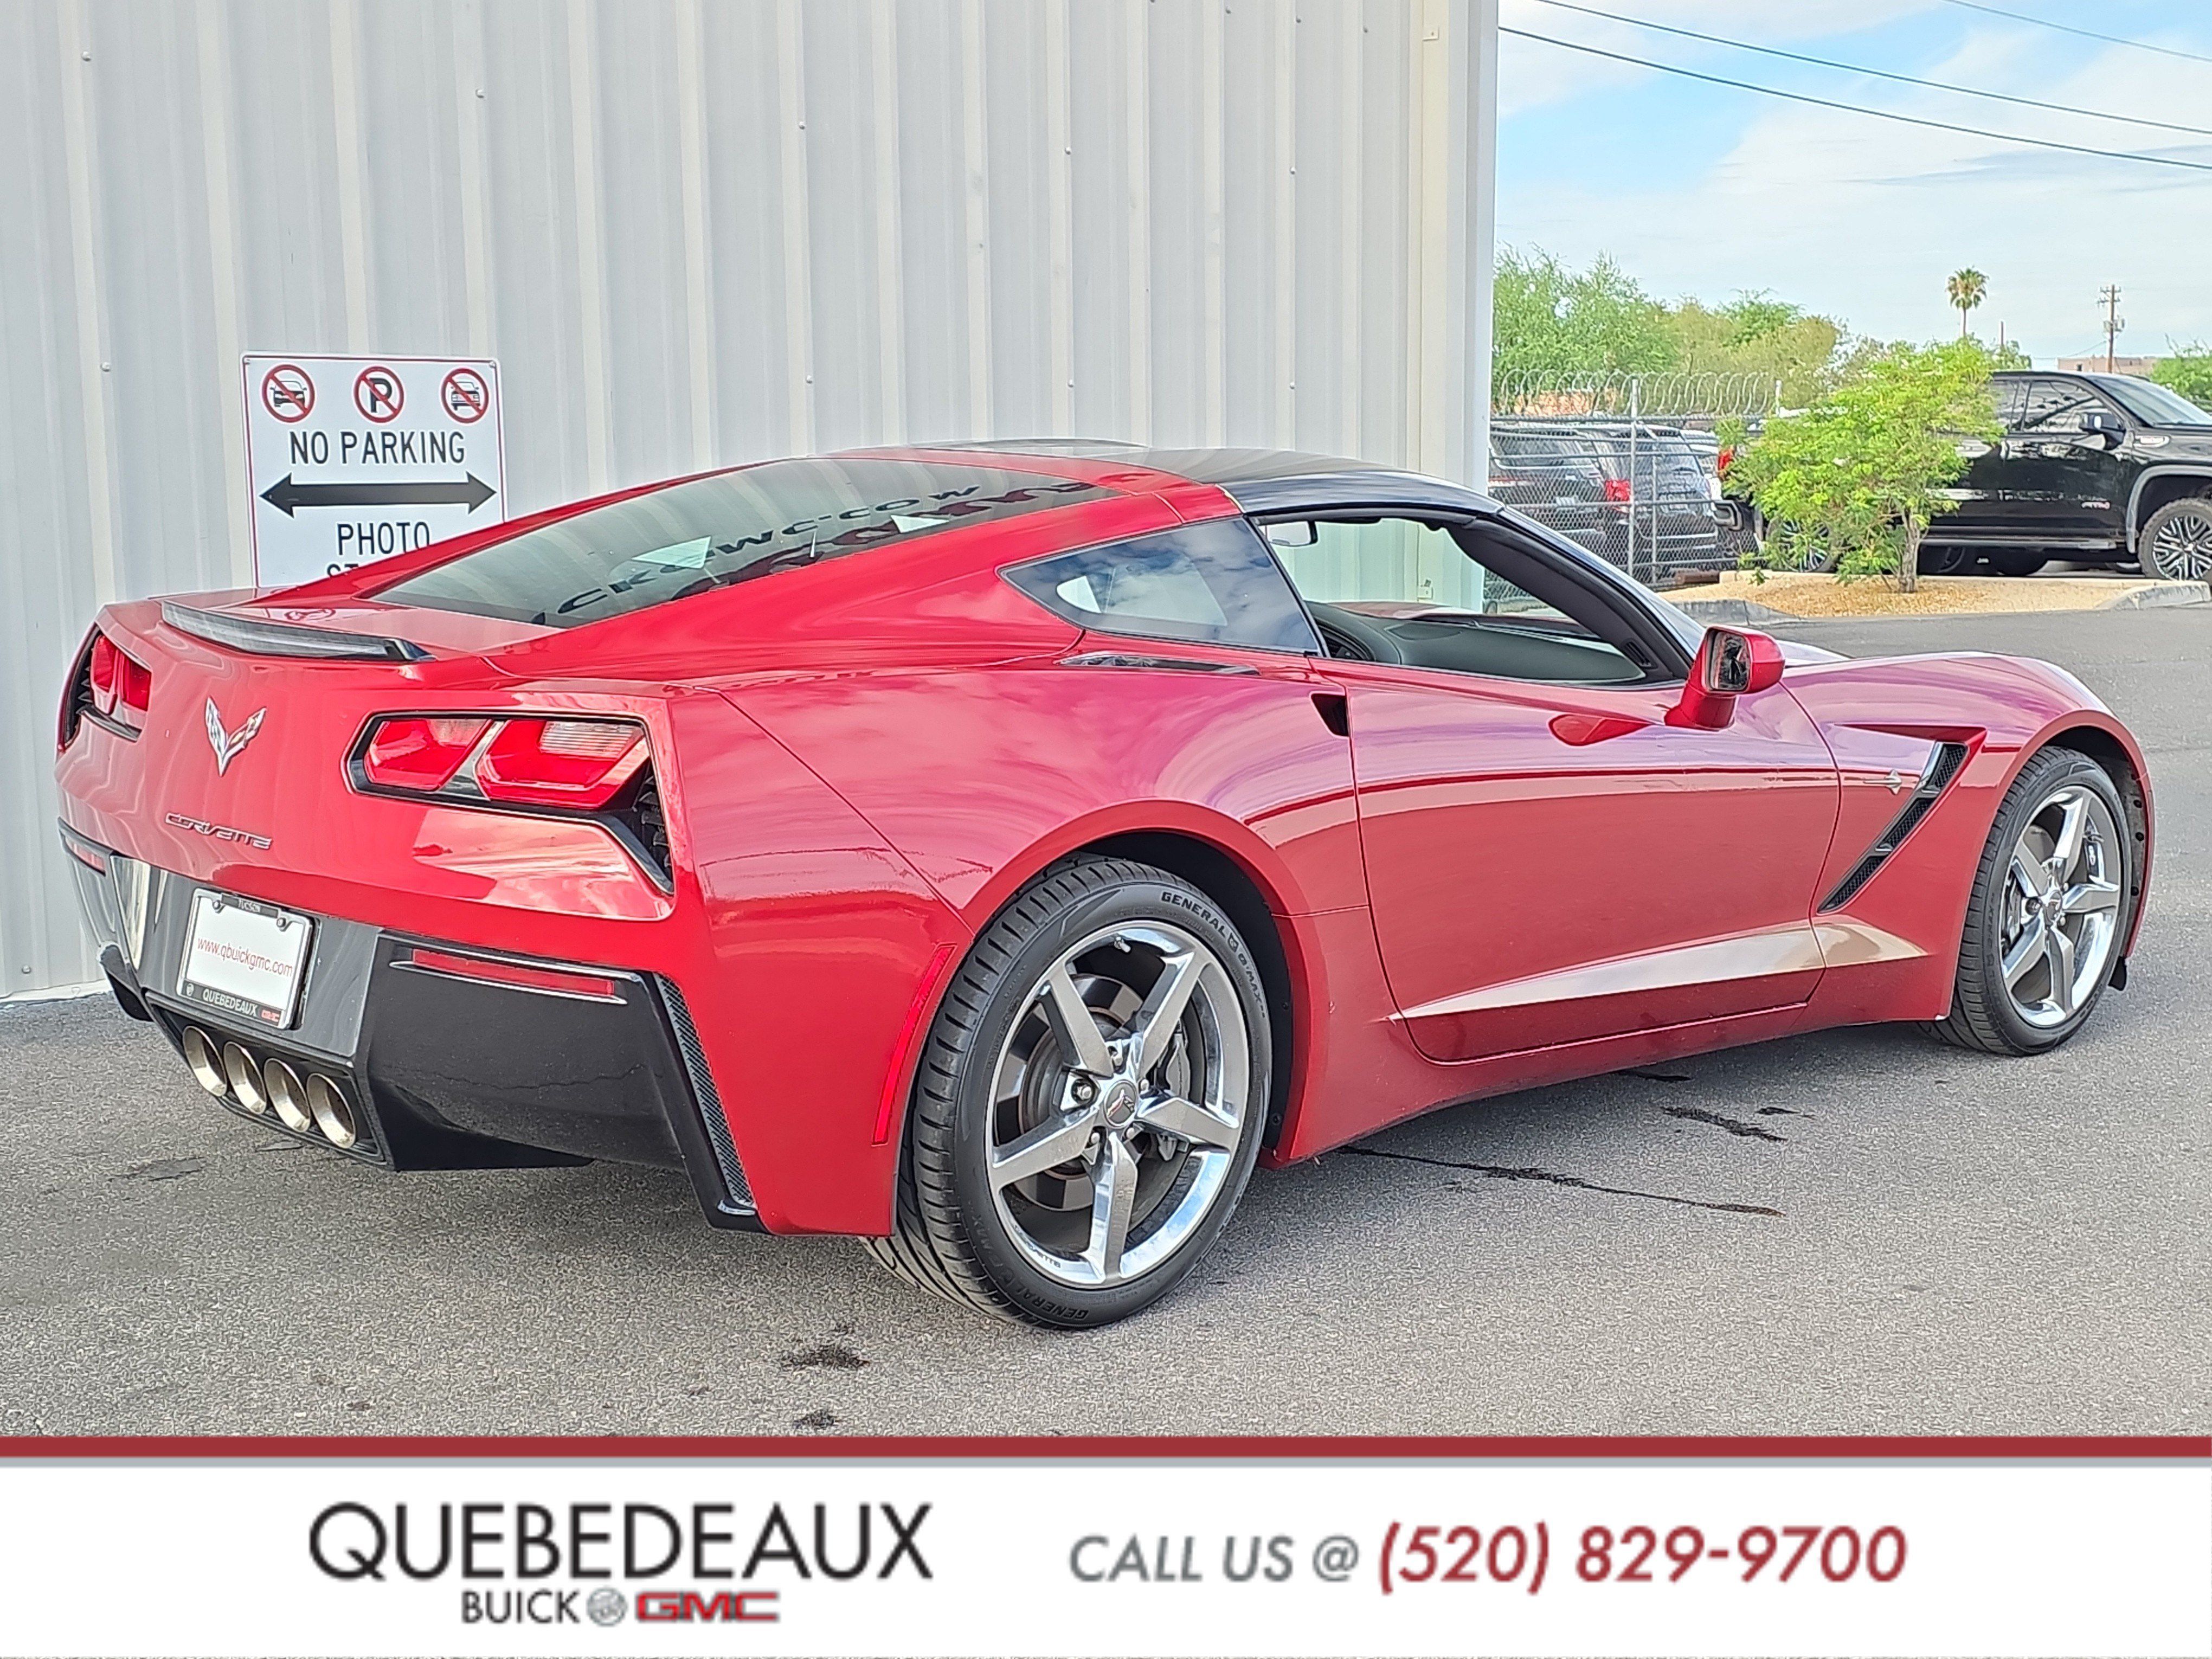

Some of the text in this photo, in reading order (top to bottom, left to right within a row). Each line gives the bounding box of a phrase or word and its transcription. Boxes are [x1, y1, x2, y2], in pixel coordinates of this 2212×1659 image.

[290, 432, 465, 465] NO PARKING
[337, 521, 430, 556] PHOTO
[165, 812, 273, 850] CORVETTE
[1161, 891, 1226, 938] GENERAL
[198, 937, 293, 977] www.qbuickgmc.com
[203, 988, 259, 1018] QUEBEDEAUX
